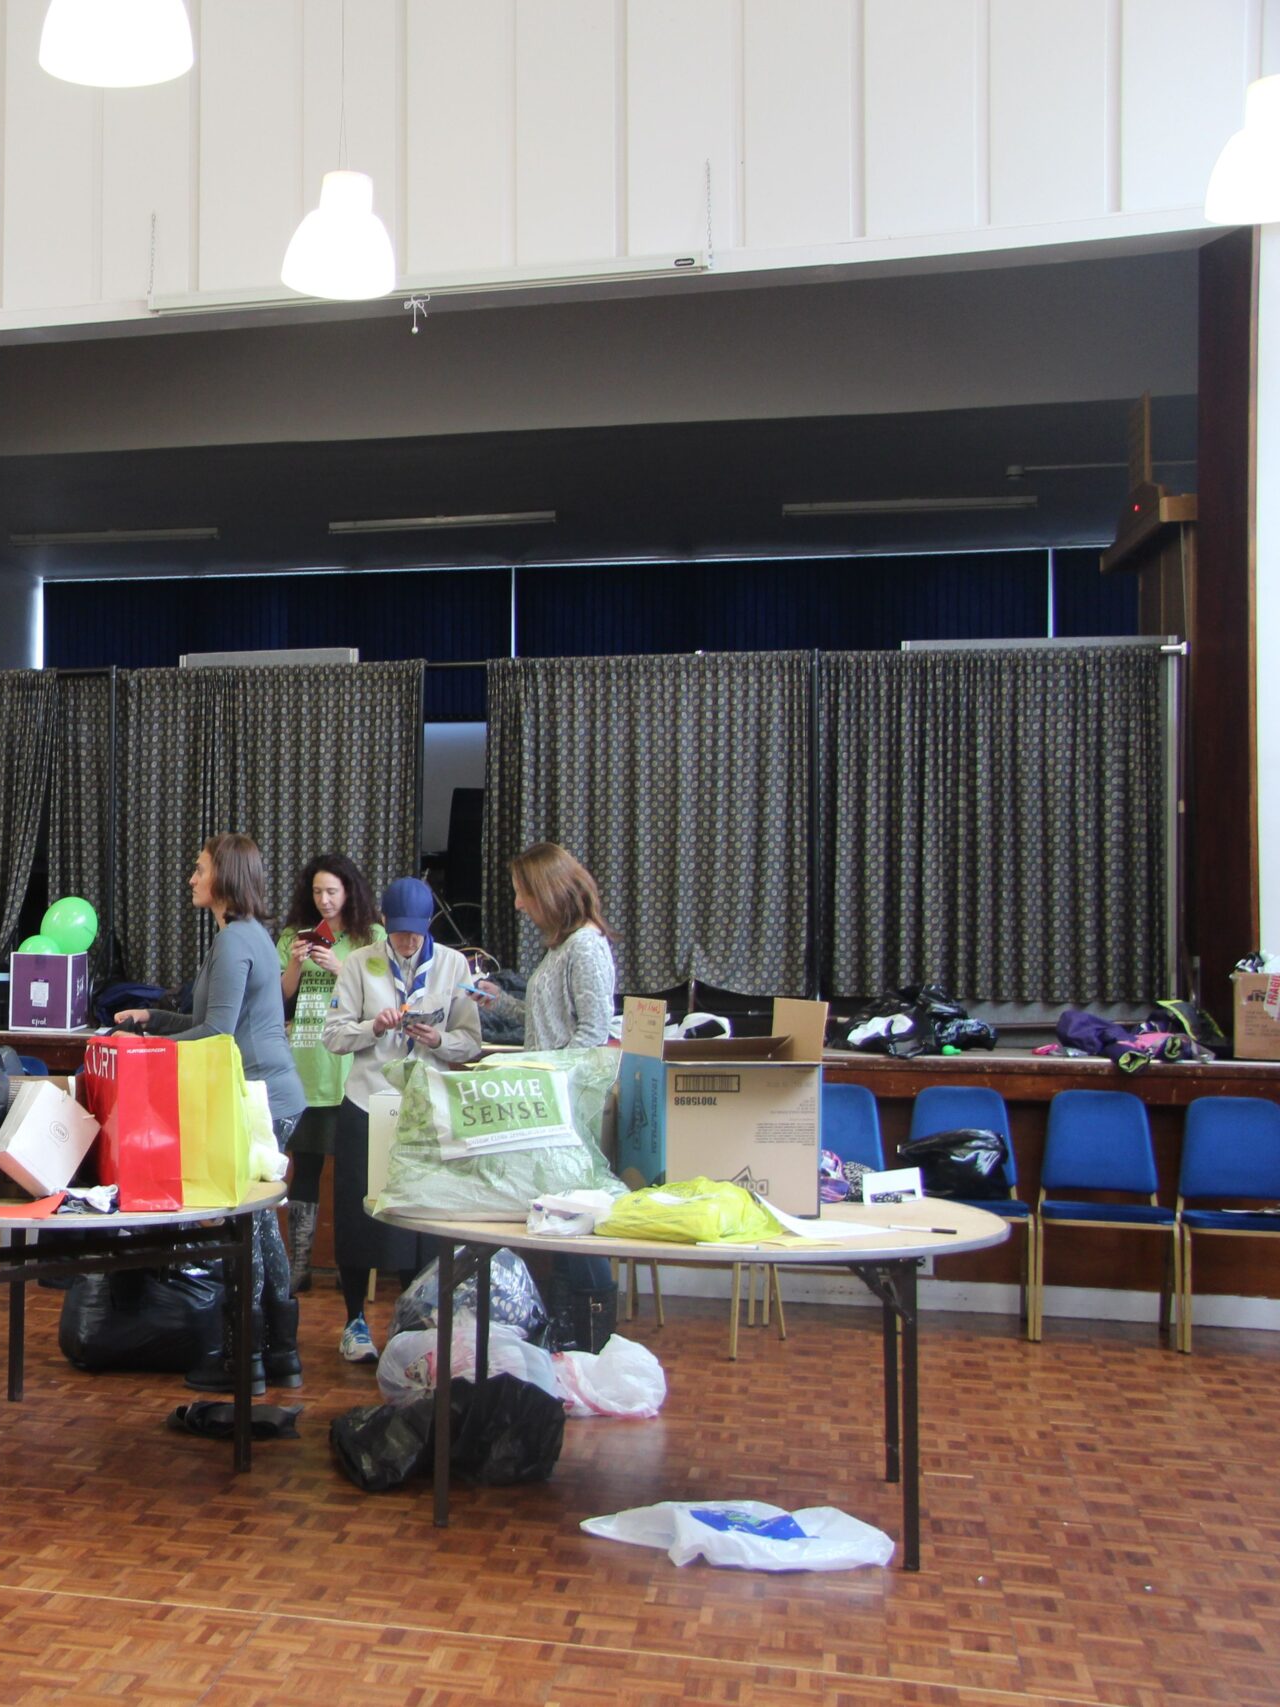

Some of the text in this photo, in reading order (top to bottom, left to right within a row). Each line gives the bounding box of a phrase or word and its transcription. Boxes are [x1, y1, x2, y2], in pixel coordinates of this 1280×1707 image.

[456, 1078, 543, 1105] HOME
[674, 1096, 718, 1106] 70015898
[462, 1102, 548, 1127] SENSE
